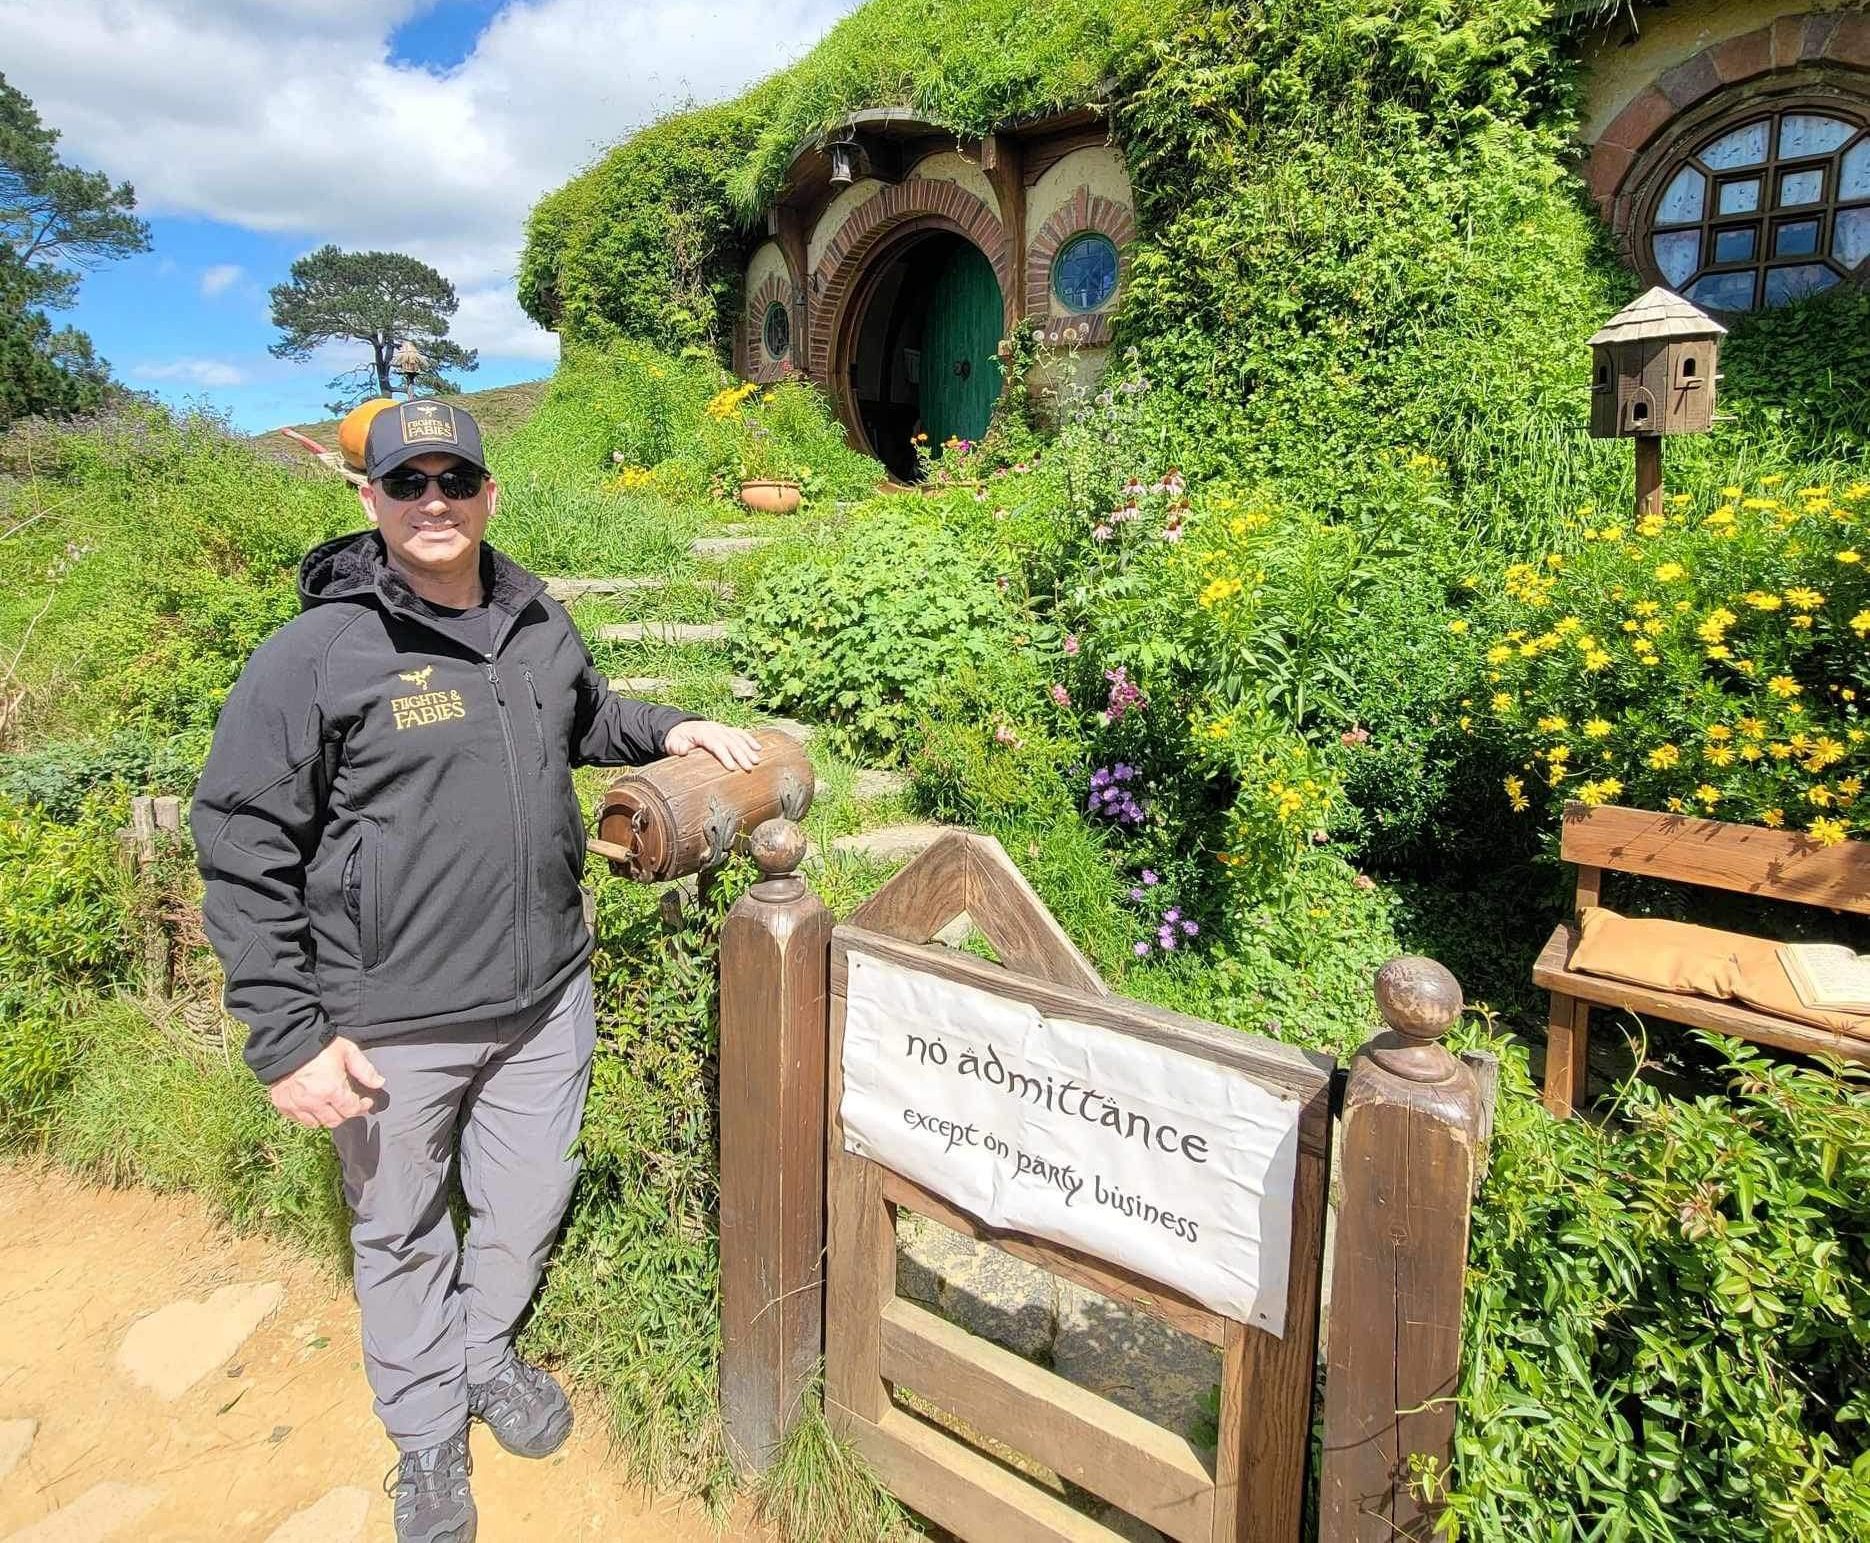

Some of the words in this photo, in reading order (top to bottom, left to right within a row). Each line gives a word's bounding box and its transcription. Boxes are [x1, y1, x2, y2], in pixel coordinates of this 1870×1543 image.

[450, 689, 461, 701] &
[903, 1109, 980, 1153] except
[1095, 1175, 1199, 1242] business
